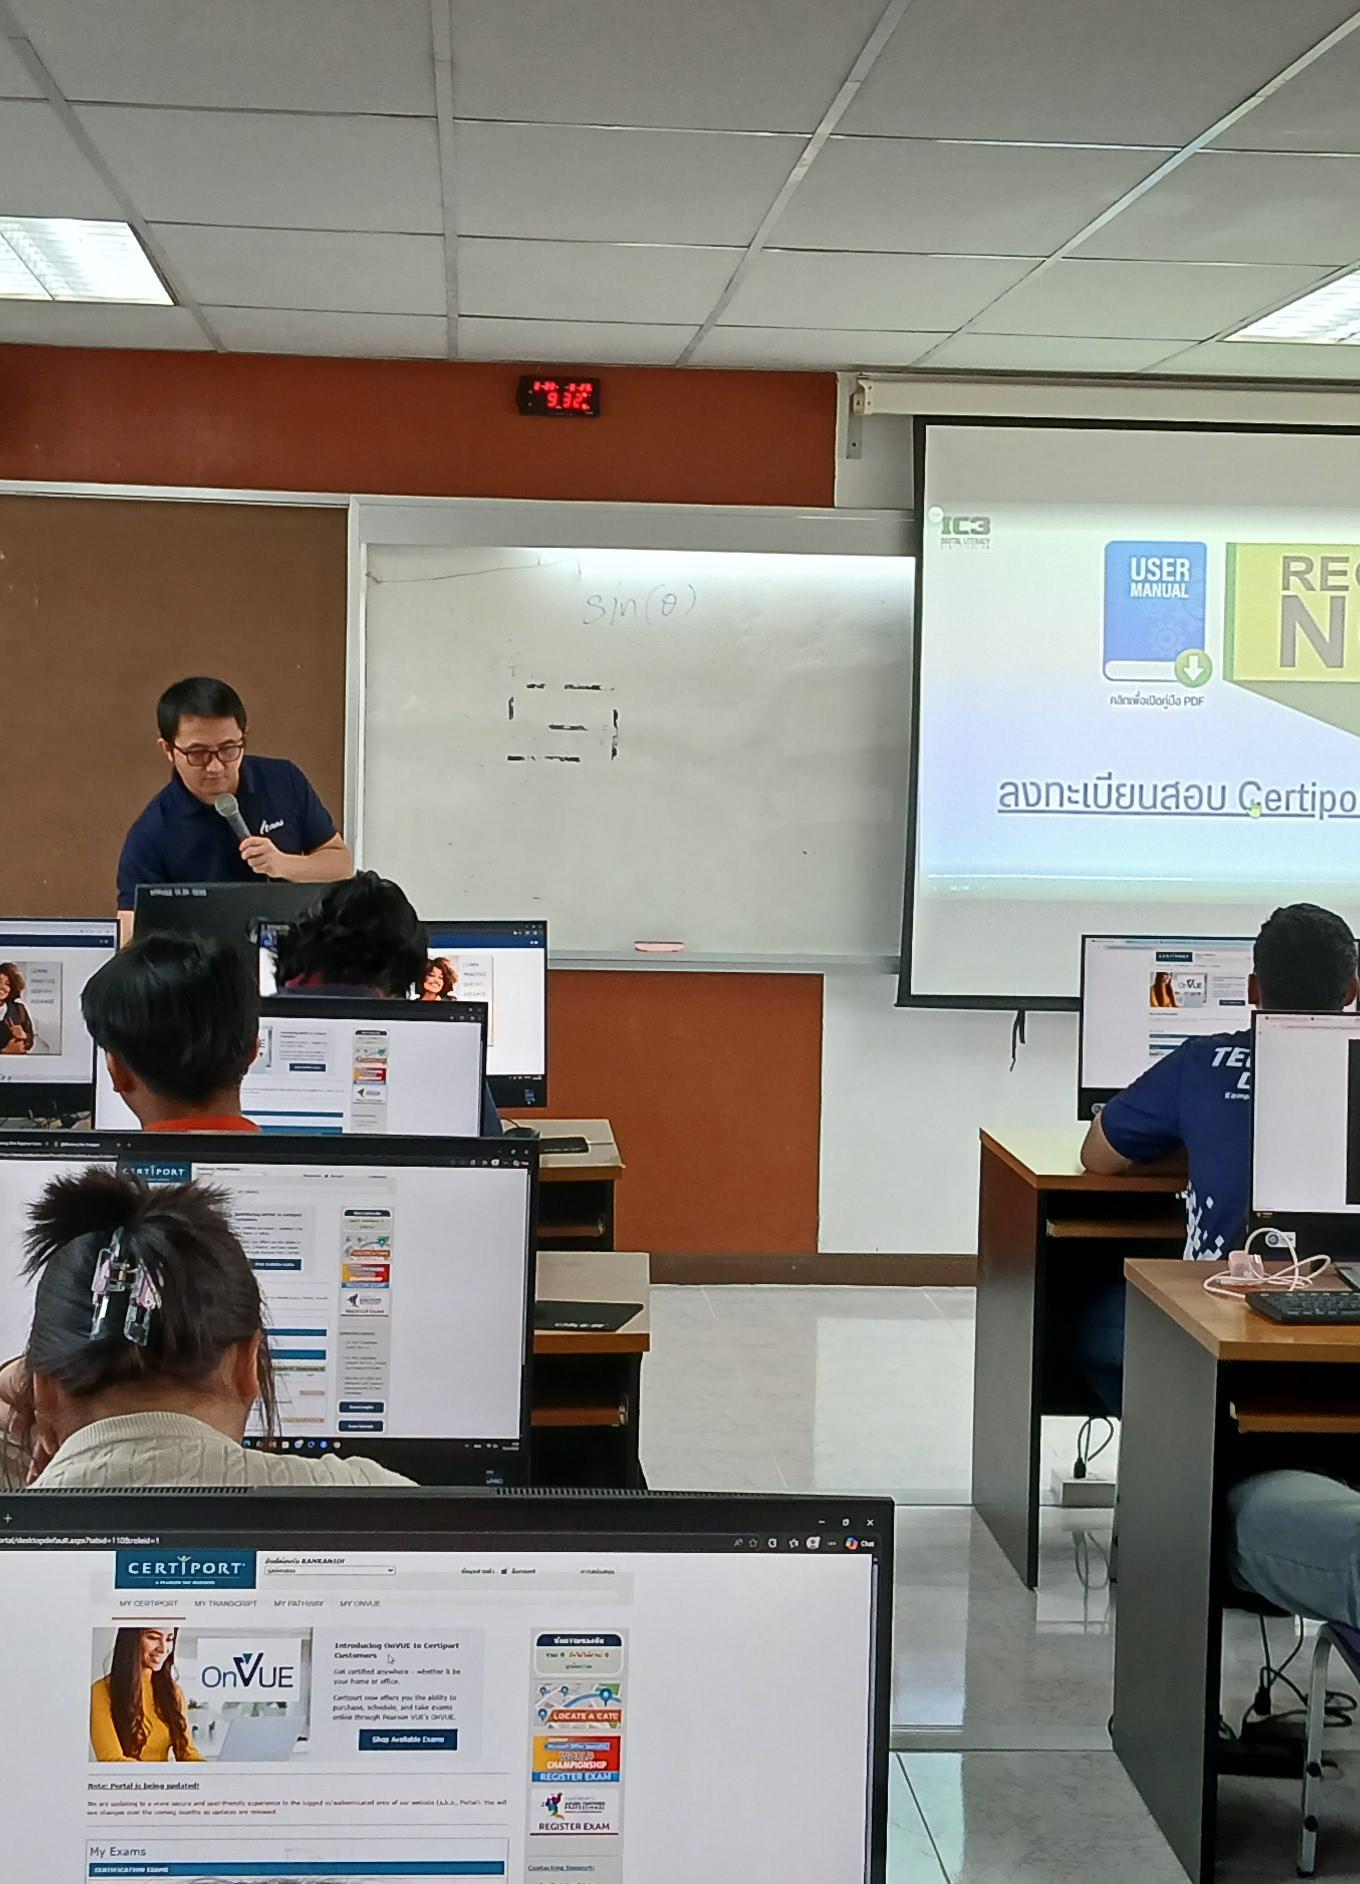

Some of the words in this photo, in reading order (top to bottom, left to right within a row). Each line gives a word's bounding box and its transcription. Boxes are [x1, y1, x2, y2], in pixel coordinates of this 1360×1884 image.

[940, 516, 991, 535] IC3
[1130, 556, 1190, 582] USER
[1130, 582, 1190, 599] MANUAL
[1183, 694, 1205, 707] PDF
[998, 771, 1227, 813] ลงทะเบียนสอบ
[127, 1557, 243, 1576] CERTIPORT
[201, 1652, 295, 1690] OnVUE
[553, 1712, 587, 1720] LOCATE
[587, 1712, 595, 1720] A
[596, 1712, 619, 1720] CATC
[540, 1773, 583, 1781] REGISTER
[584, 1773, 612, 1781] EXAM
[538, 1823, 583, 1831] REGISTER
[583, 1823, 610, 1831] EXAM
[90, 1847, 105, 1858] My
[110, 1847, 147, 1856] Exams
